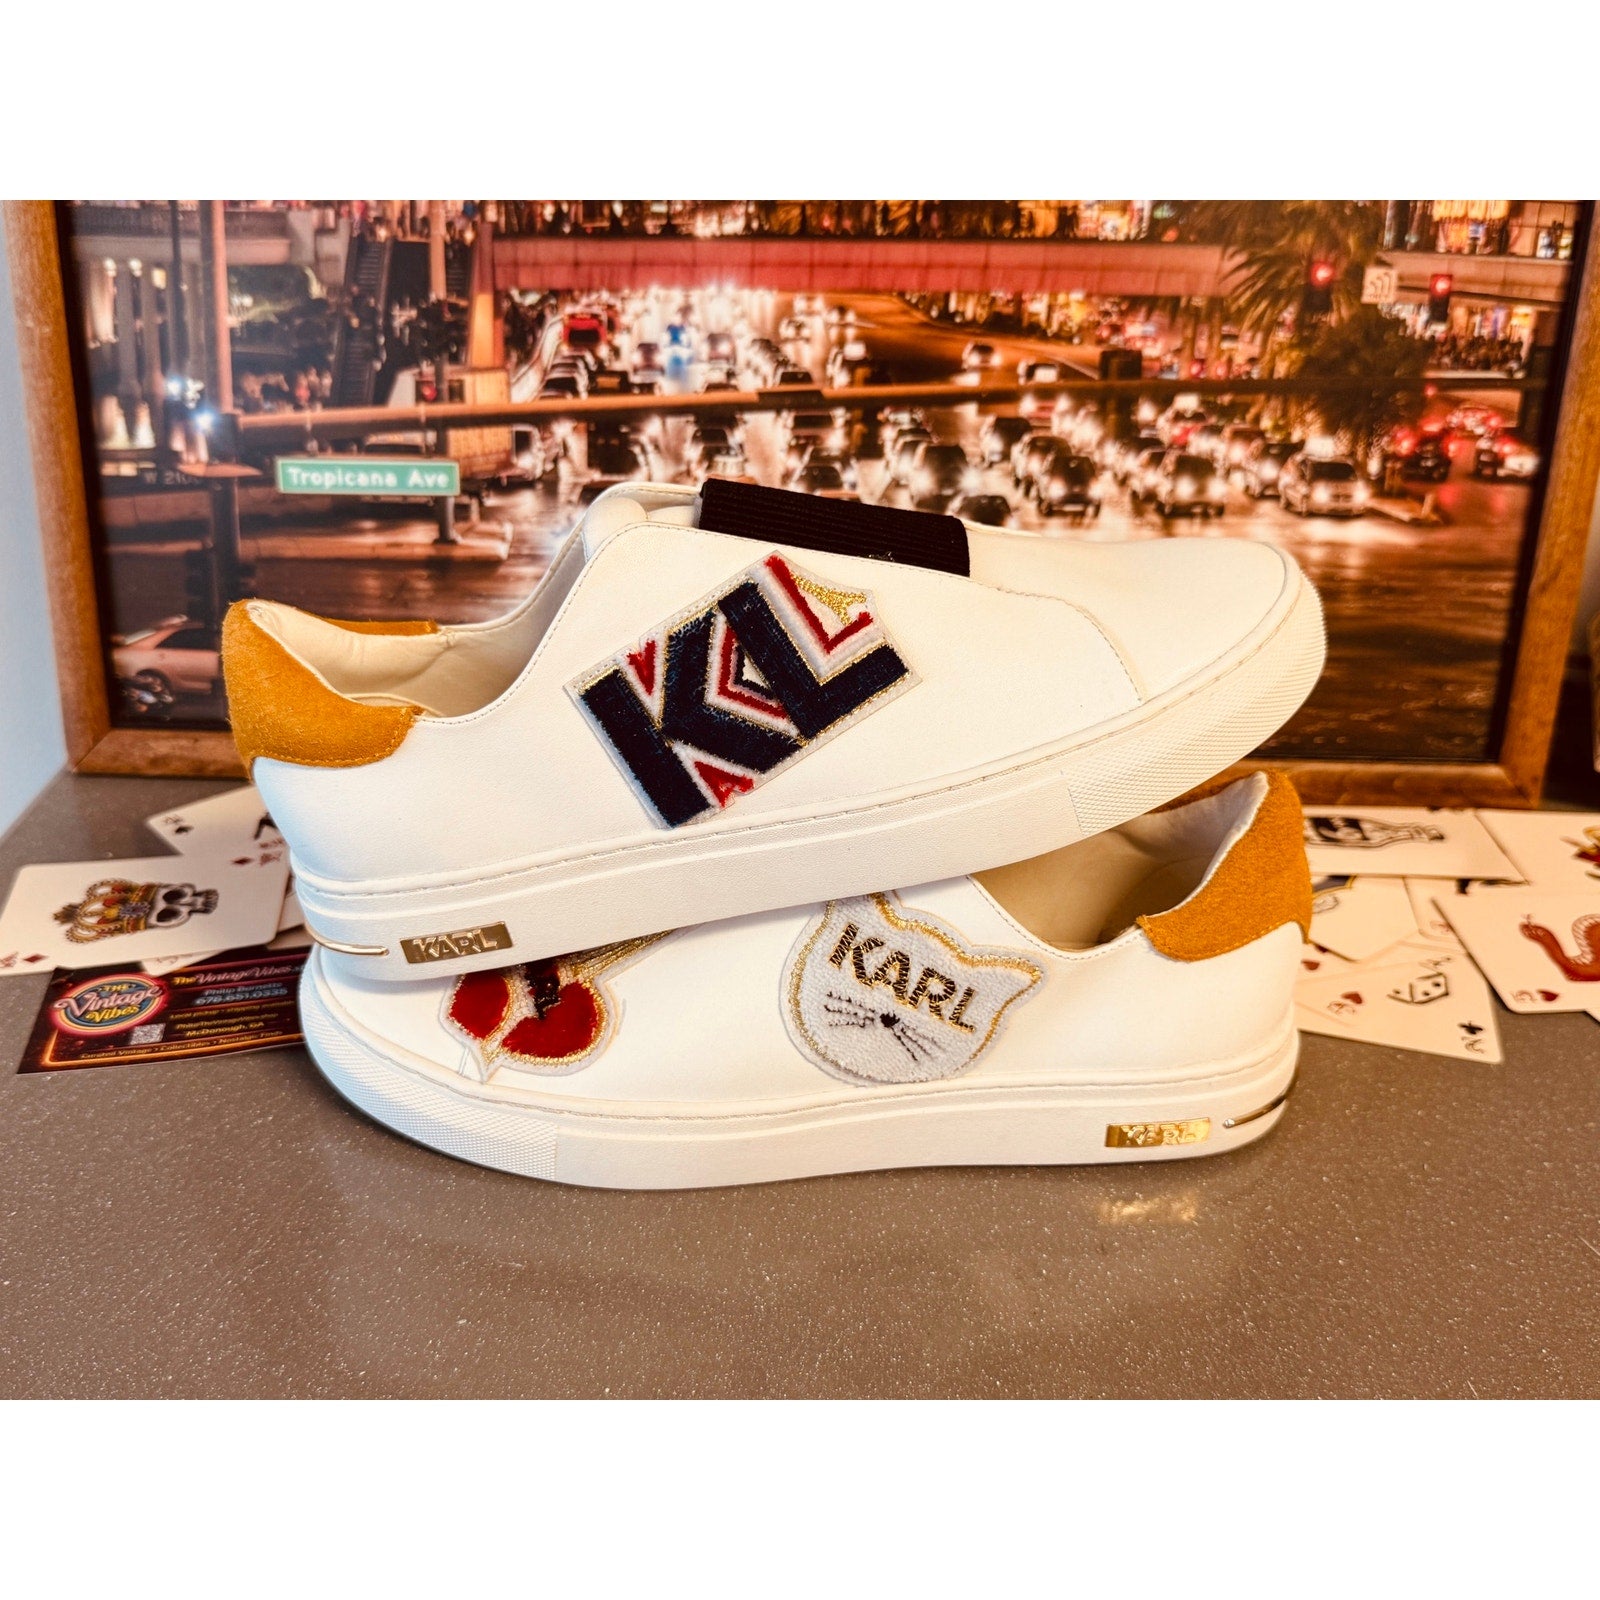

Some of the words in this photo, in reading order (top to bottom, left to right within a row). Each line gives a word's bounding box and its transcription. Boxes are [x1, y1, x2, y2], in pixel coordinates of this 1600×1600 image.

[288, 467, 397, 490] Tropicana
[407, 468, 450, 489] Ave
[577, 579, 911, 829] KL
[412, 928, 498, 960] KARL
[829, 922, 977, 1036] KARL
[53, 985, 163, 1017] Vintage
[85, 1004, 140, 1023] Vibes
[1120, 1121, 1197, 1146] KARL
